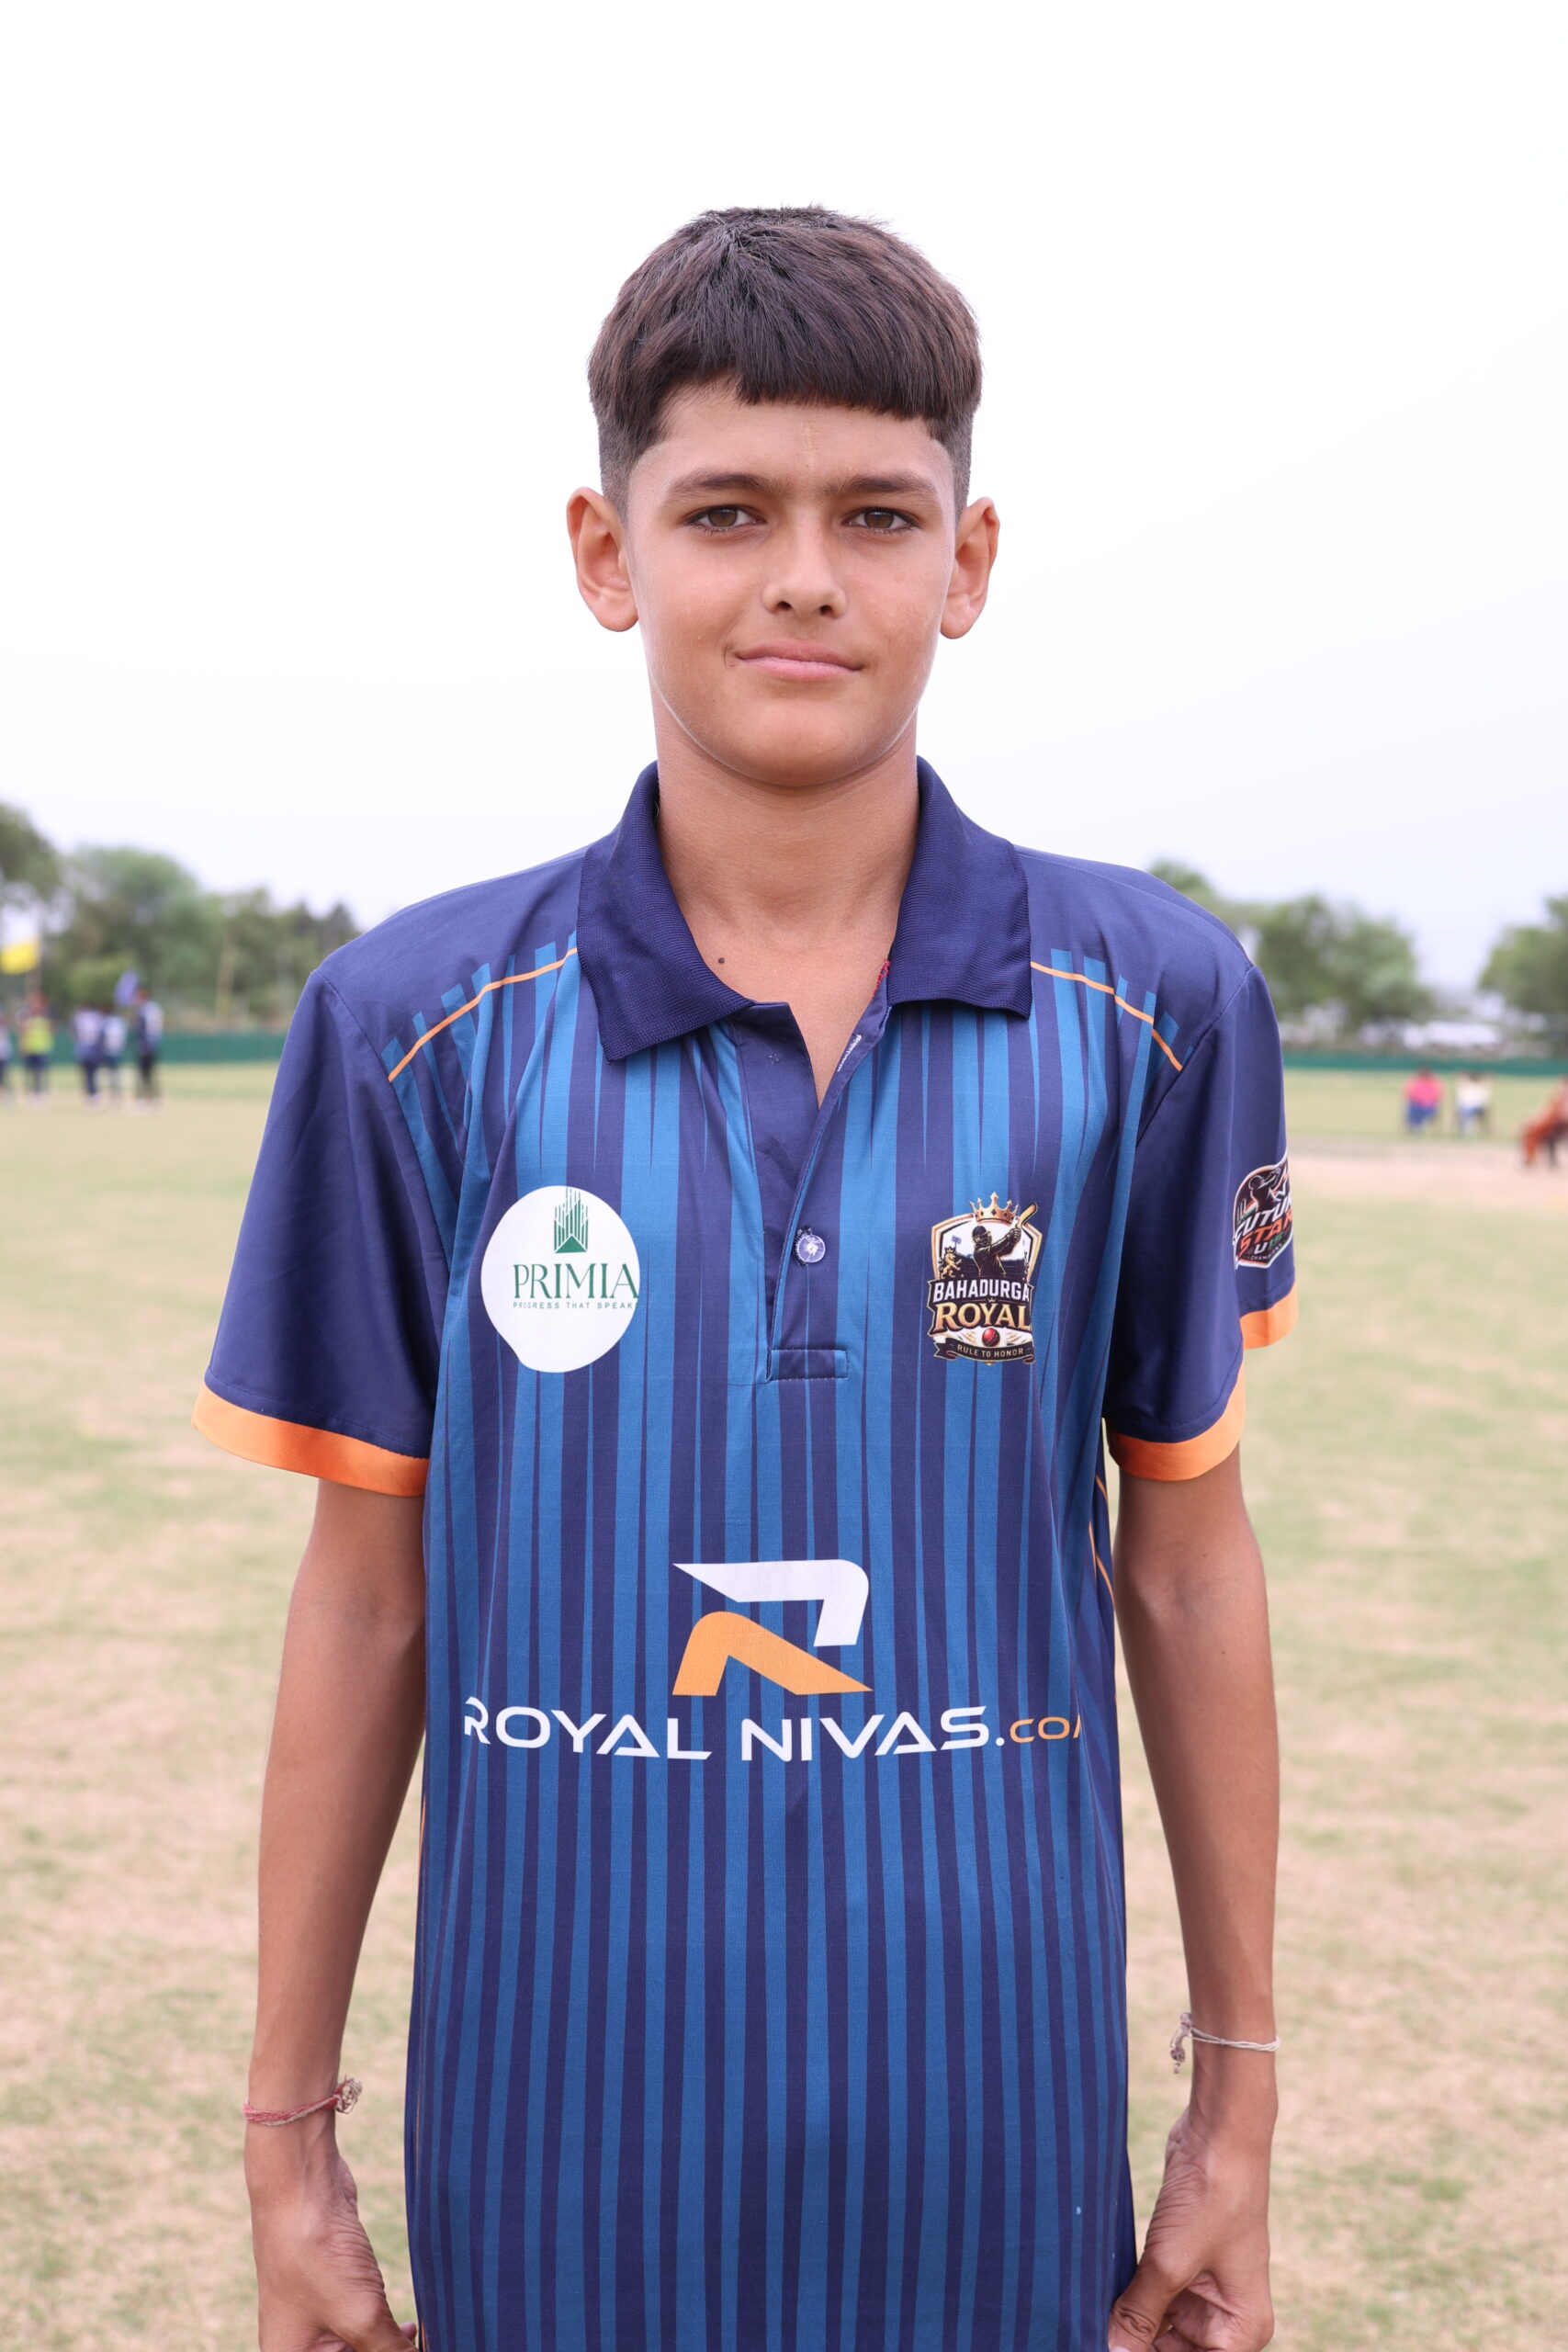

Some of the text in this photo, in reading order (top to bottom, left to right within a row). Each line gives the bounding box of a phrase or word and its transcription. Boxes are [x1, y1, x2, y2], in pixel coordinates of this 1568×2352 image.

[513, 1263, 639, 1299] PRIMIA
[932, 1279, 1029, 1303] BAHADURGA
[566, 1301, 591, 1309] THAT
[931, 1303, 1032, 1332] ROYAL
[956, 1343, 1024, 1358] RULE TO HONOR
[464, 1696, 712, 1760] ROYAL
